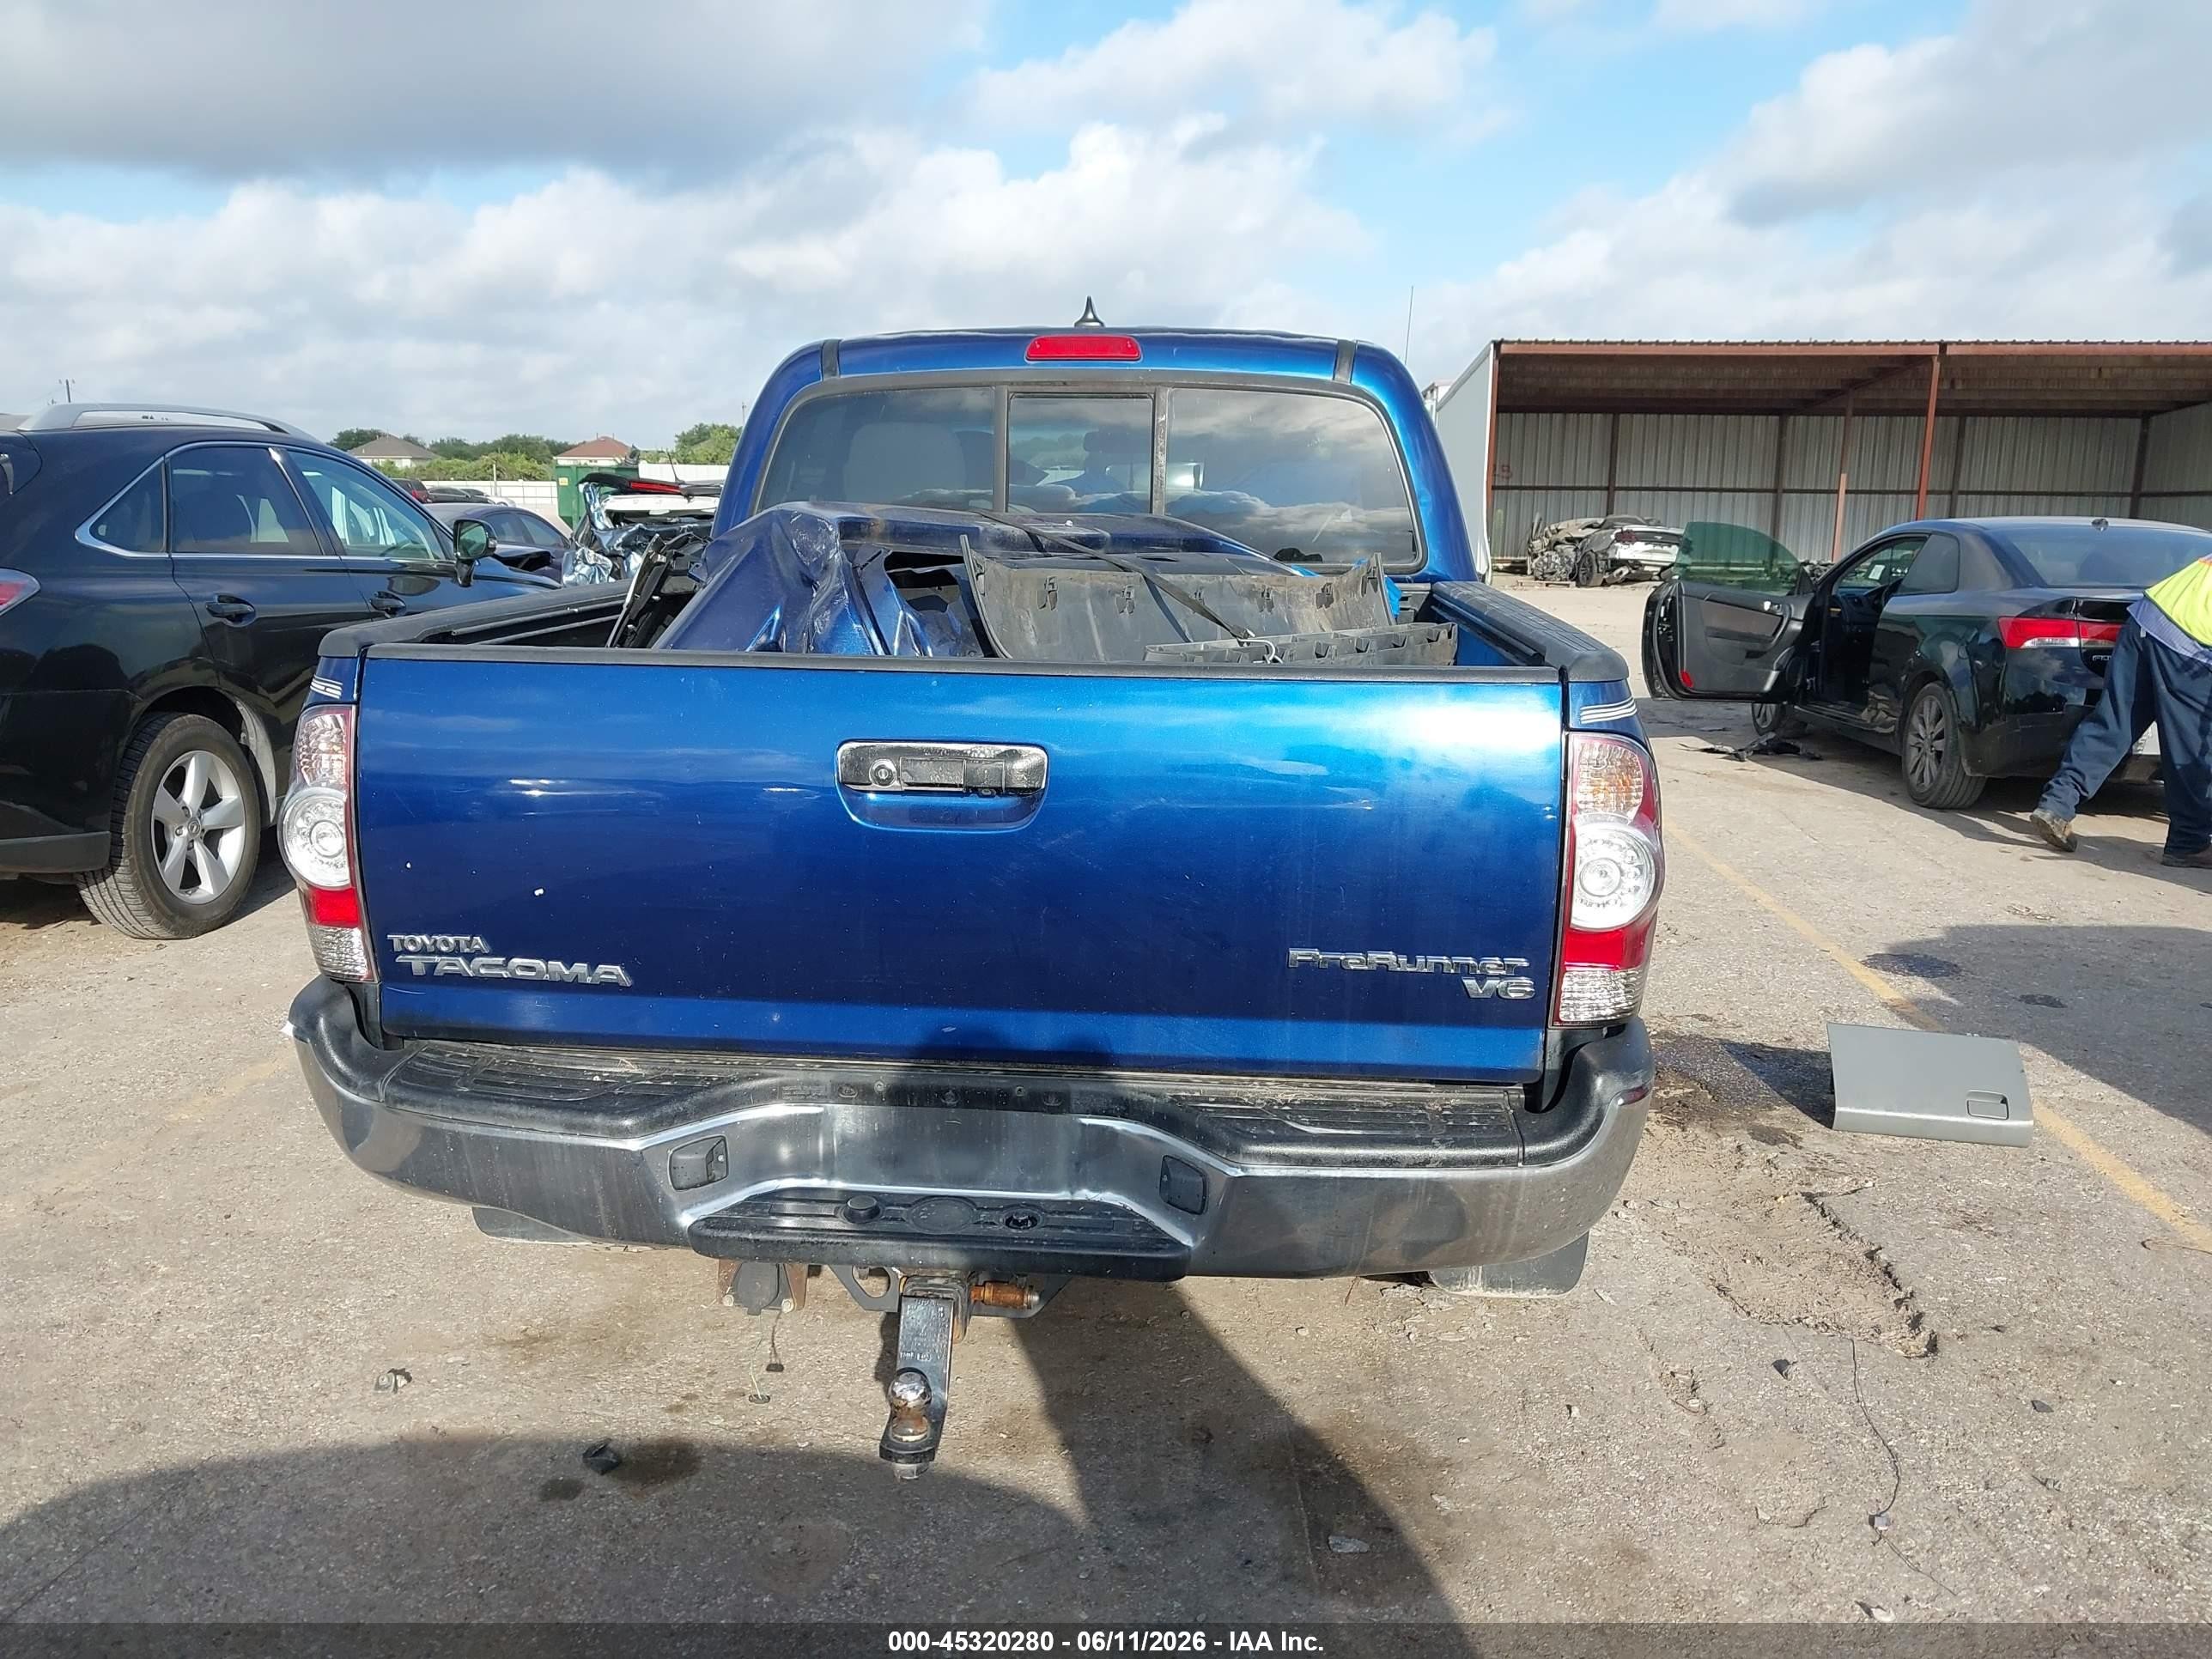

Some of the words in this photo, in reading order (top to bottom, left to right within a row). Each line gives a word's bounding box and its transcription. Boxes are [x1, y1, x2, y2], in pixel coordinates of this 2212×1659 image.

[386, 934, 490, 954] TOYOTA
[395, 956, 633, 988] TACOMA
[1288, 947, 1530, 975] PreRunner
[1462, 976, 1536, 1000] V6
